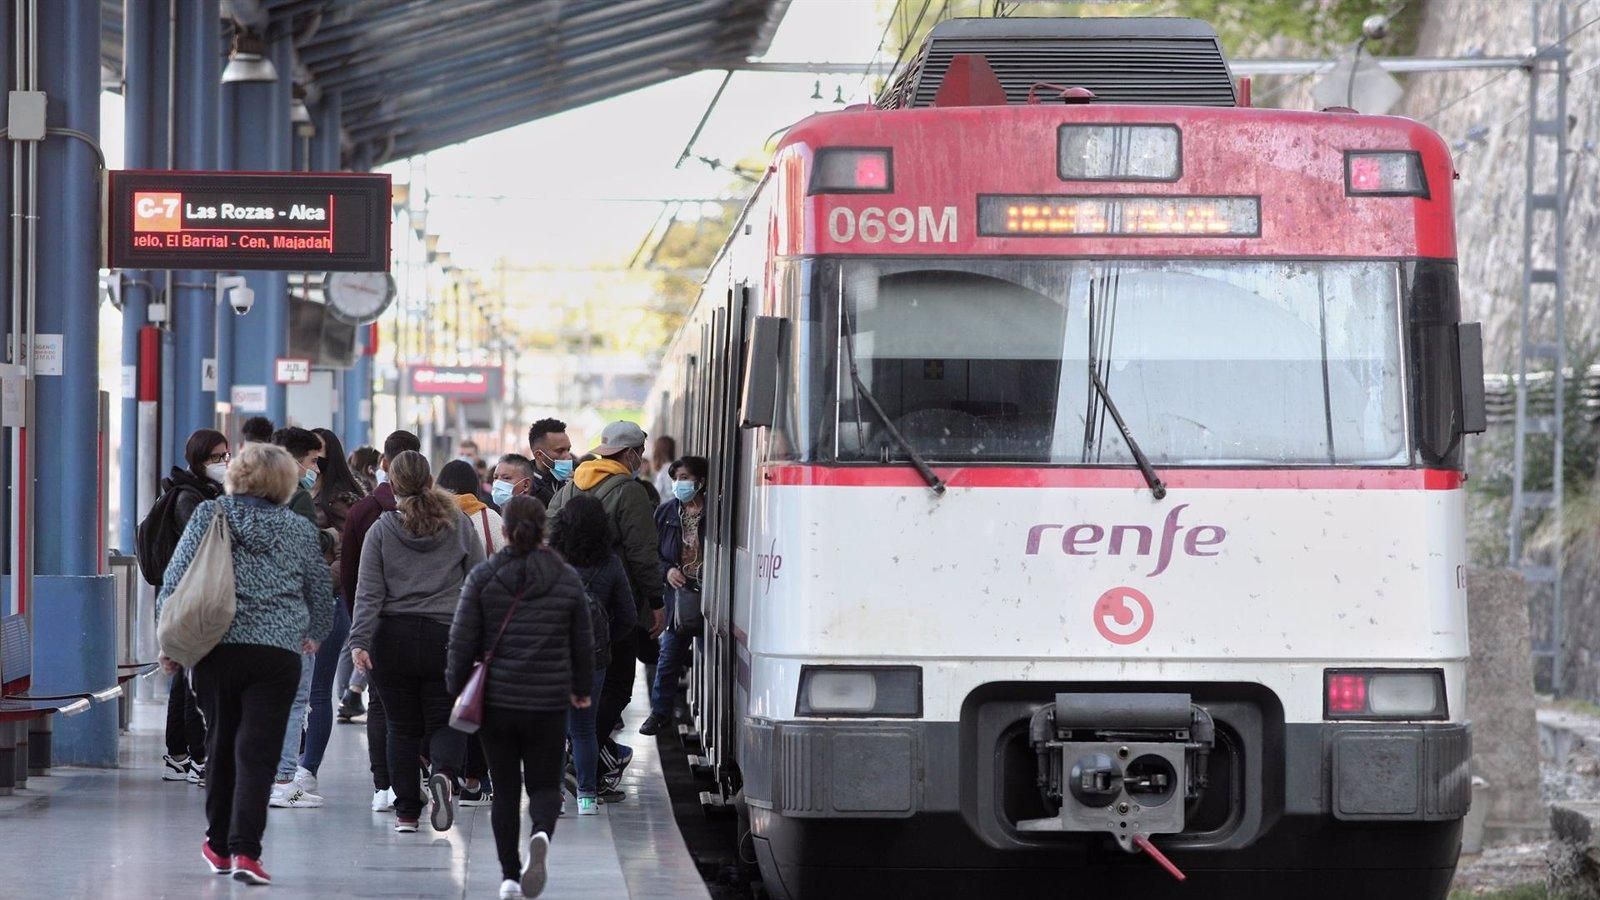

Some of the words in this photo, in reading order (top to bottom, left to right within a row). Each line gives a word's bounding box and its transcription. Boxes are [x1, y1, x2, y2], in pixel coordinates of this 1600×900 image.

[137, 198, 179, 219] C-7
[186, 203, 217, 219] Las
[221, 203, 275, 220] Rozas
[289, 204, 326, 220] Alca
[828, 206, 958, 243] 069M
[166, 235, 178, 247] El
[182, 234, 228, 248] Barrial
[1025, 503, 1226, 577] renfe
[756, 538, 782, 595] renfe
